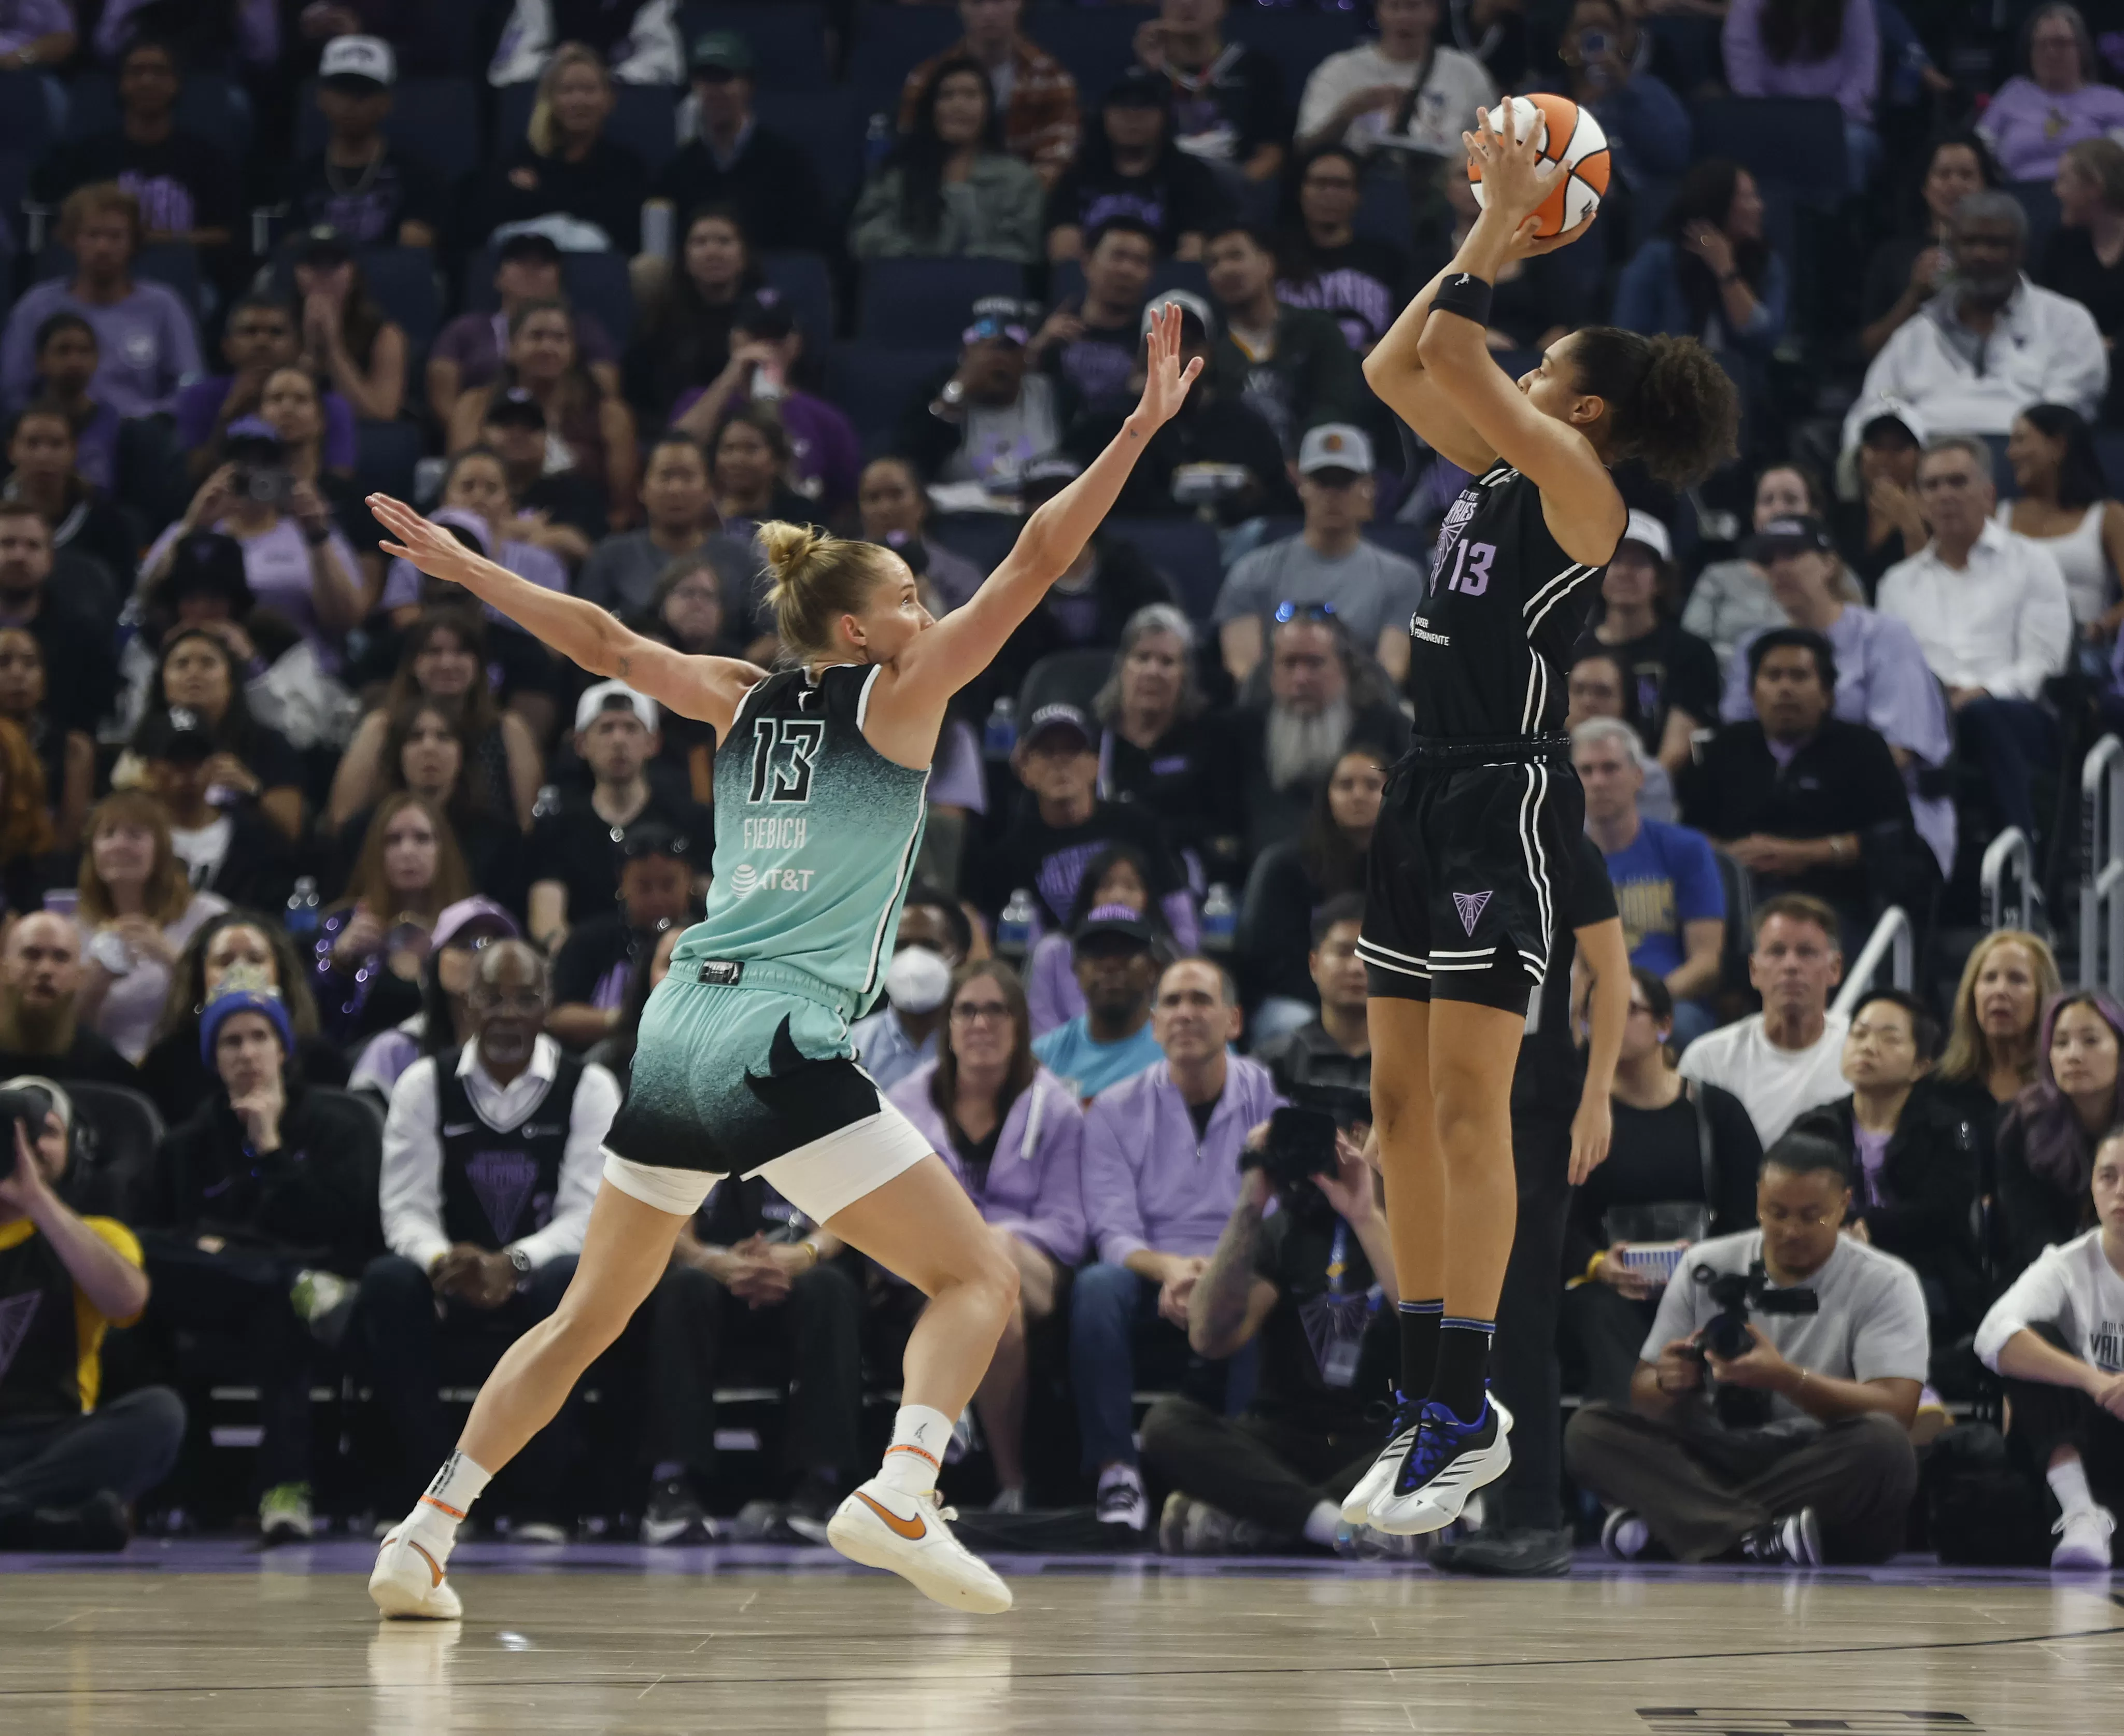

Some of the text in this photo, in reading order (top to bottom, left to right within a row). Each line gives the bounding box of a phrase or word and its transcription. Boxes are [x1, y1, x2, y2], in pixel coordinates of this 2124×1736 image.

[1448, 539, 1496, 596] 13
[1415, 616, 1429, 628] KAISER
[1414, 628, 1450, 646] PERMANENTE
[747, 717, 825, 804] 13
[744, 818, 806, 850] FIEBICH
[759, 869, 815, 892] AT&T
